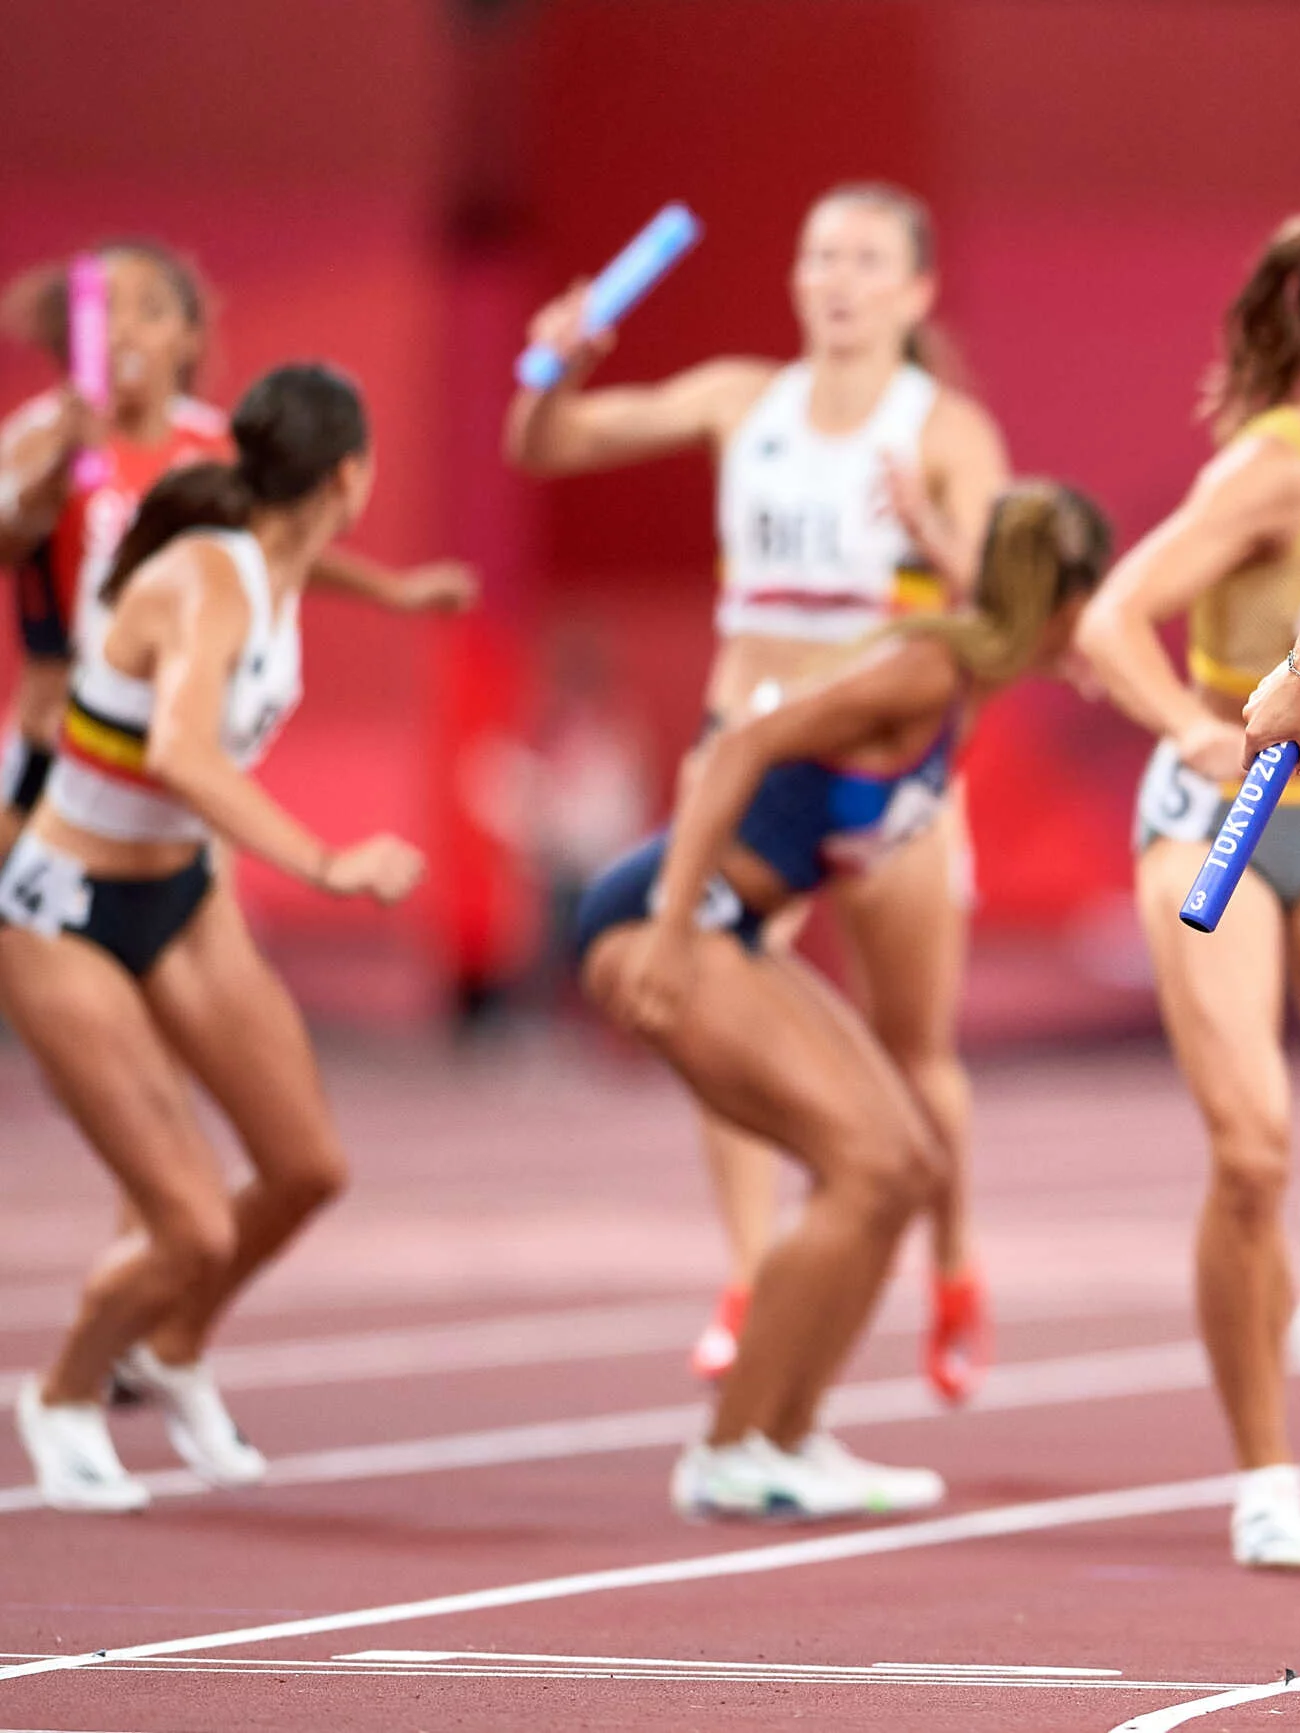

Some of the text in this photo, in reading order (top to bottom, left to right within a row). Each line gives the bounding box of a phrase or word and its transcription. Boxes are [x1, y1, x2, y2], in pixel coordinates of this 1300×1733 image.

[1204, 741, 1289, 872] TOKYO 20
[1190, 891, 1208, 911] 3
